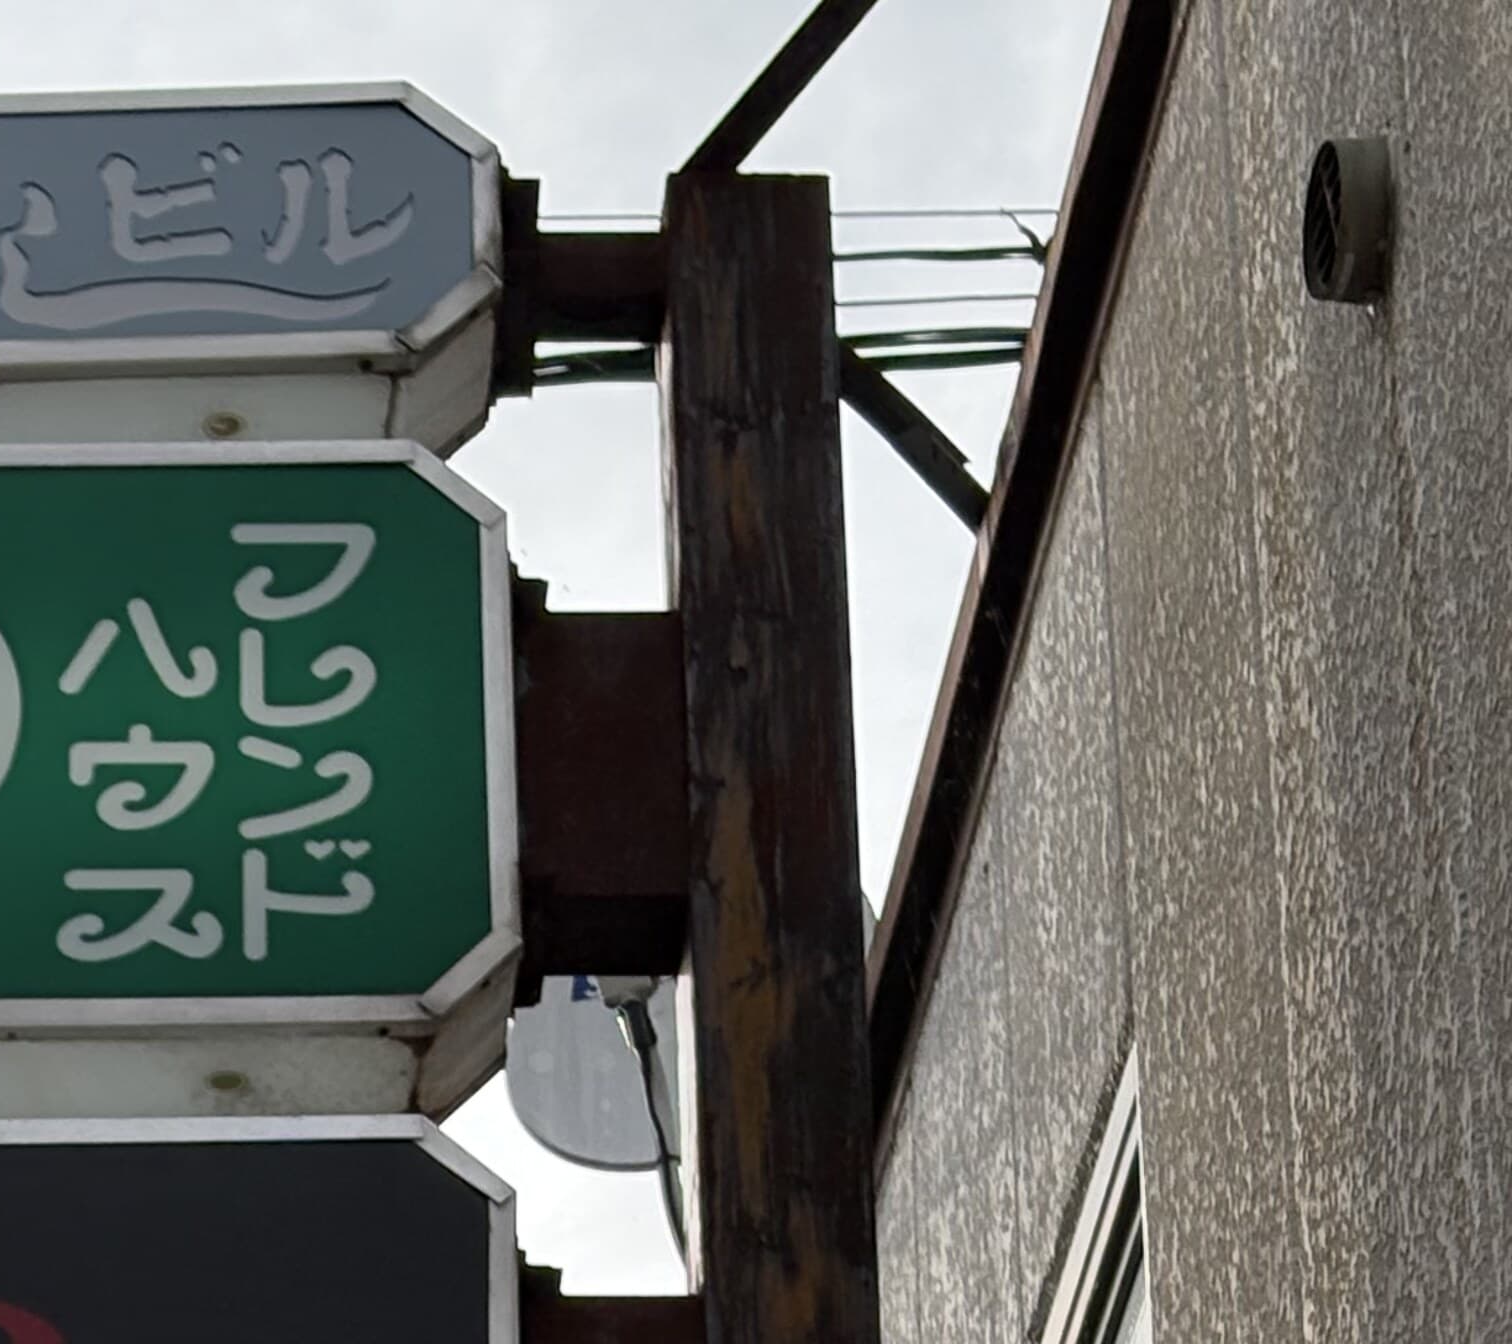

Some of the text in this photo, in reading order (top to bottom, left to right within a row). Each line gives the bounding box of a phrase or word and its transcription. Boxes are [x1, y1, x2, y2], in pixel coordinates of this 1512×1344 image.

[56, 597, 223, 962] ハウス
[230, 522, 377, 961] フレンド
